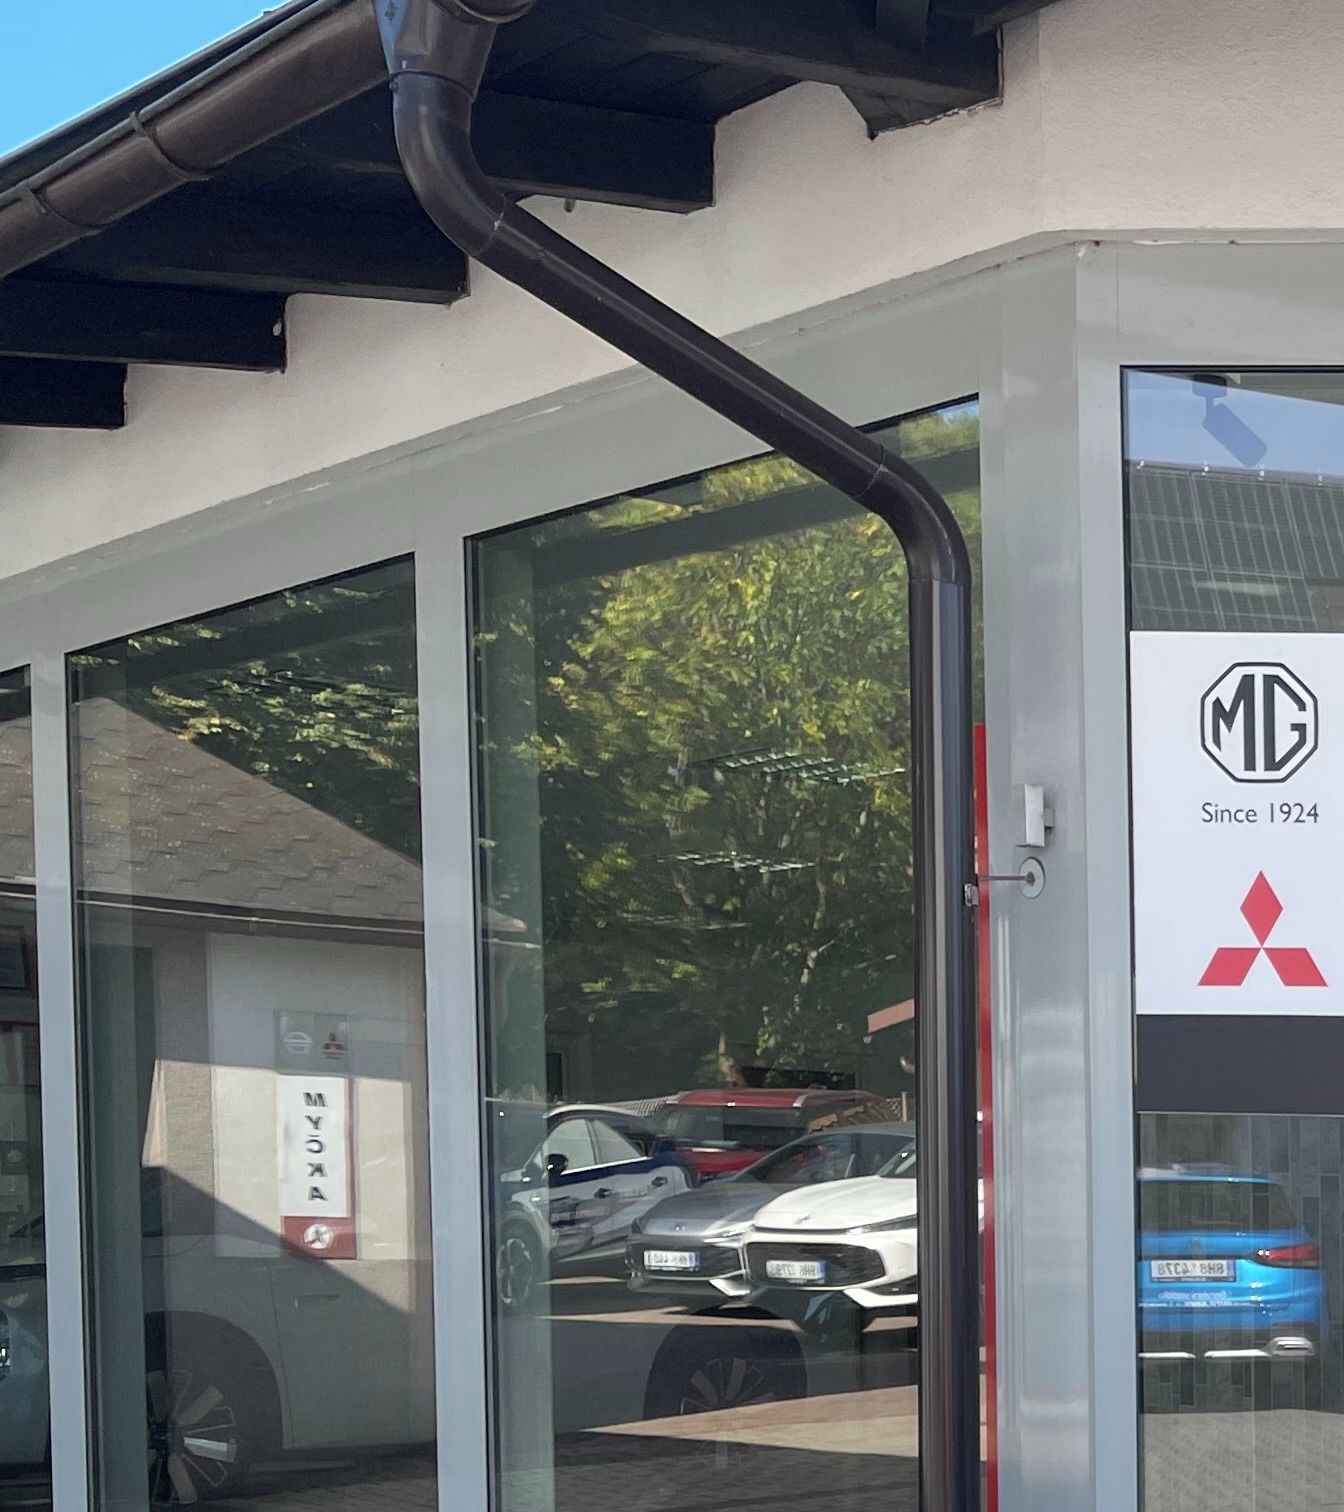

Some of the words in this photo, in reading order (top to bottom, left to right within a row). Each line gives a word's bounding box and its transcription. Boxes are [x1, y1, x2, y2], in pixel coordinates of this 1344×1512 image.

[1205, 667, 1313, 778] MG
[1201, 803, 1258, 825] Since
[1269, 804, 1320, 826] 1924
